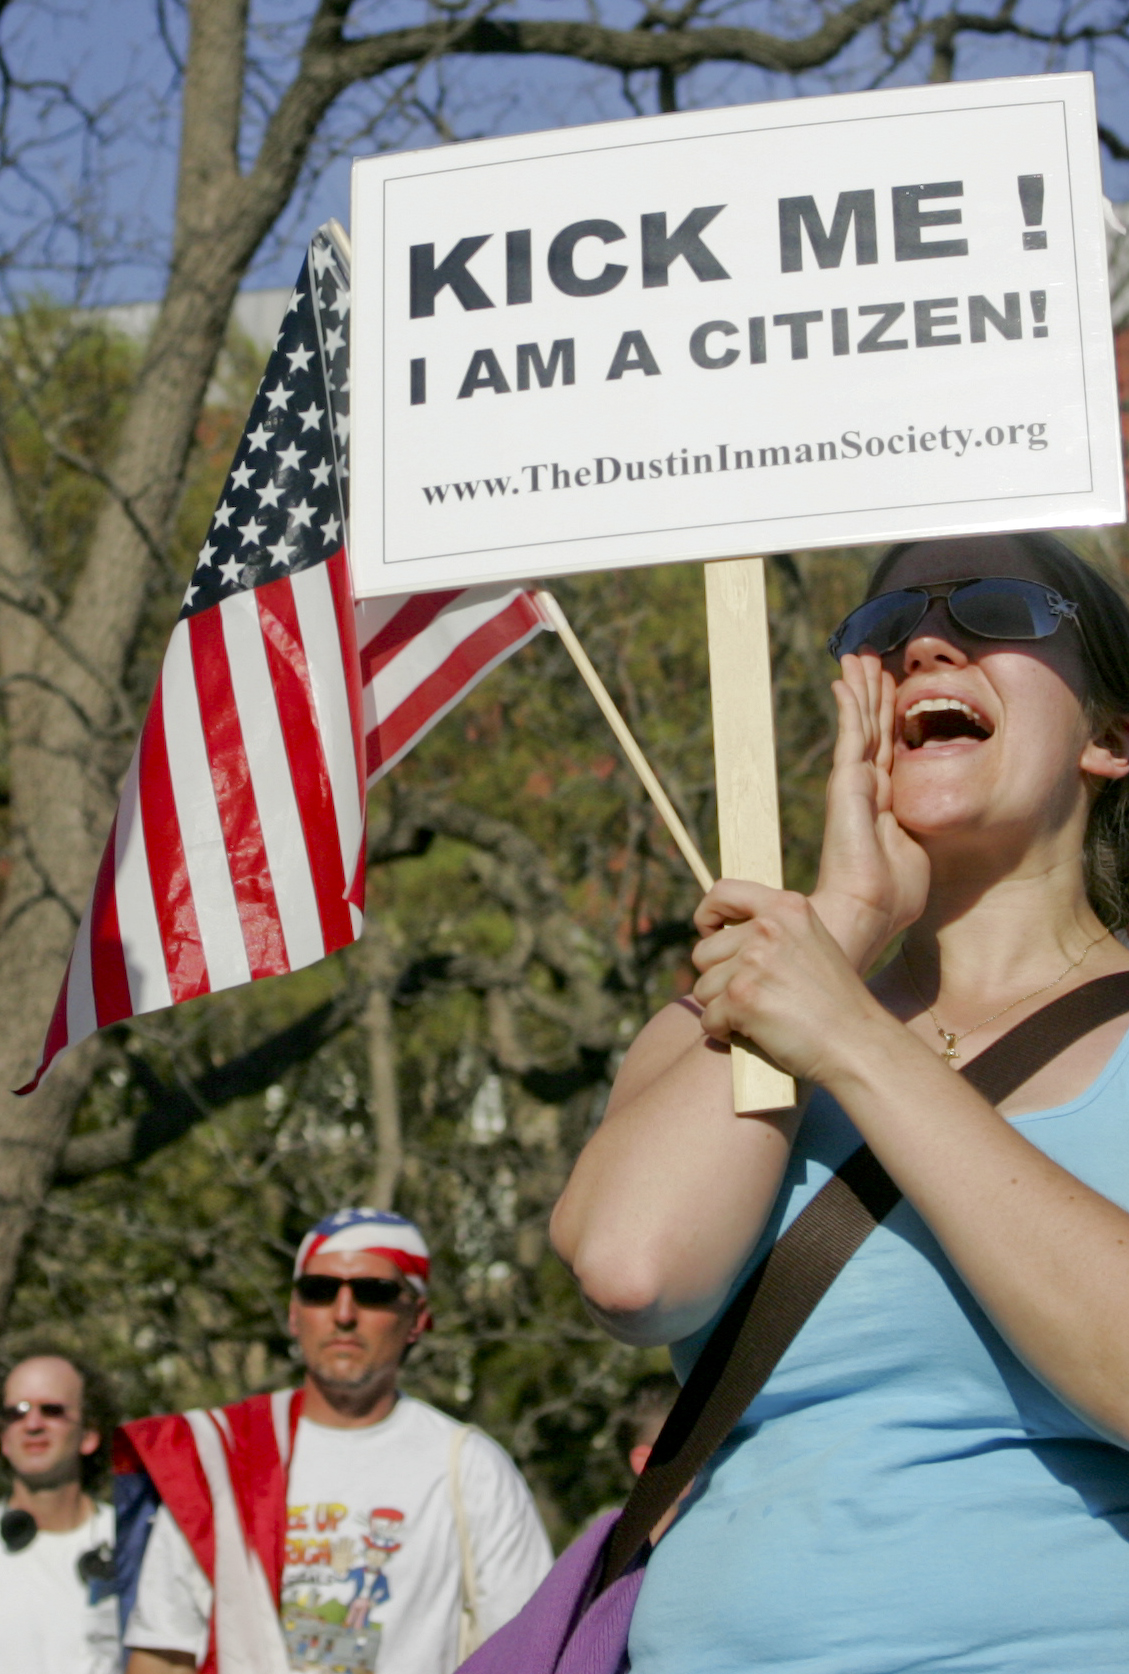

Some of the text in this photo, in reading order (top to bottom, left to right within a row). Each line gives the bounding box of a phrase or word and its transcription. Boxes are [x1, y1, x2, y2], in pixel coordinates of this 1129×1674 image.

[408, 173, 1048, 320] KICK ME !
[408, 289, 1049, 406] I AM A CITIZEN!
[421, 418, 1050, 506] www.TheDustinInmanSociety.org
